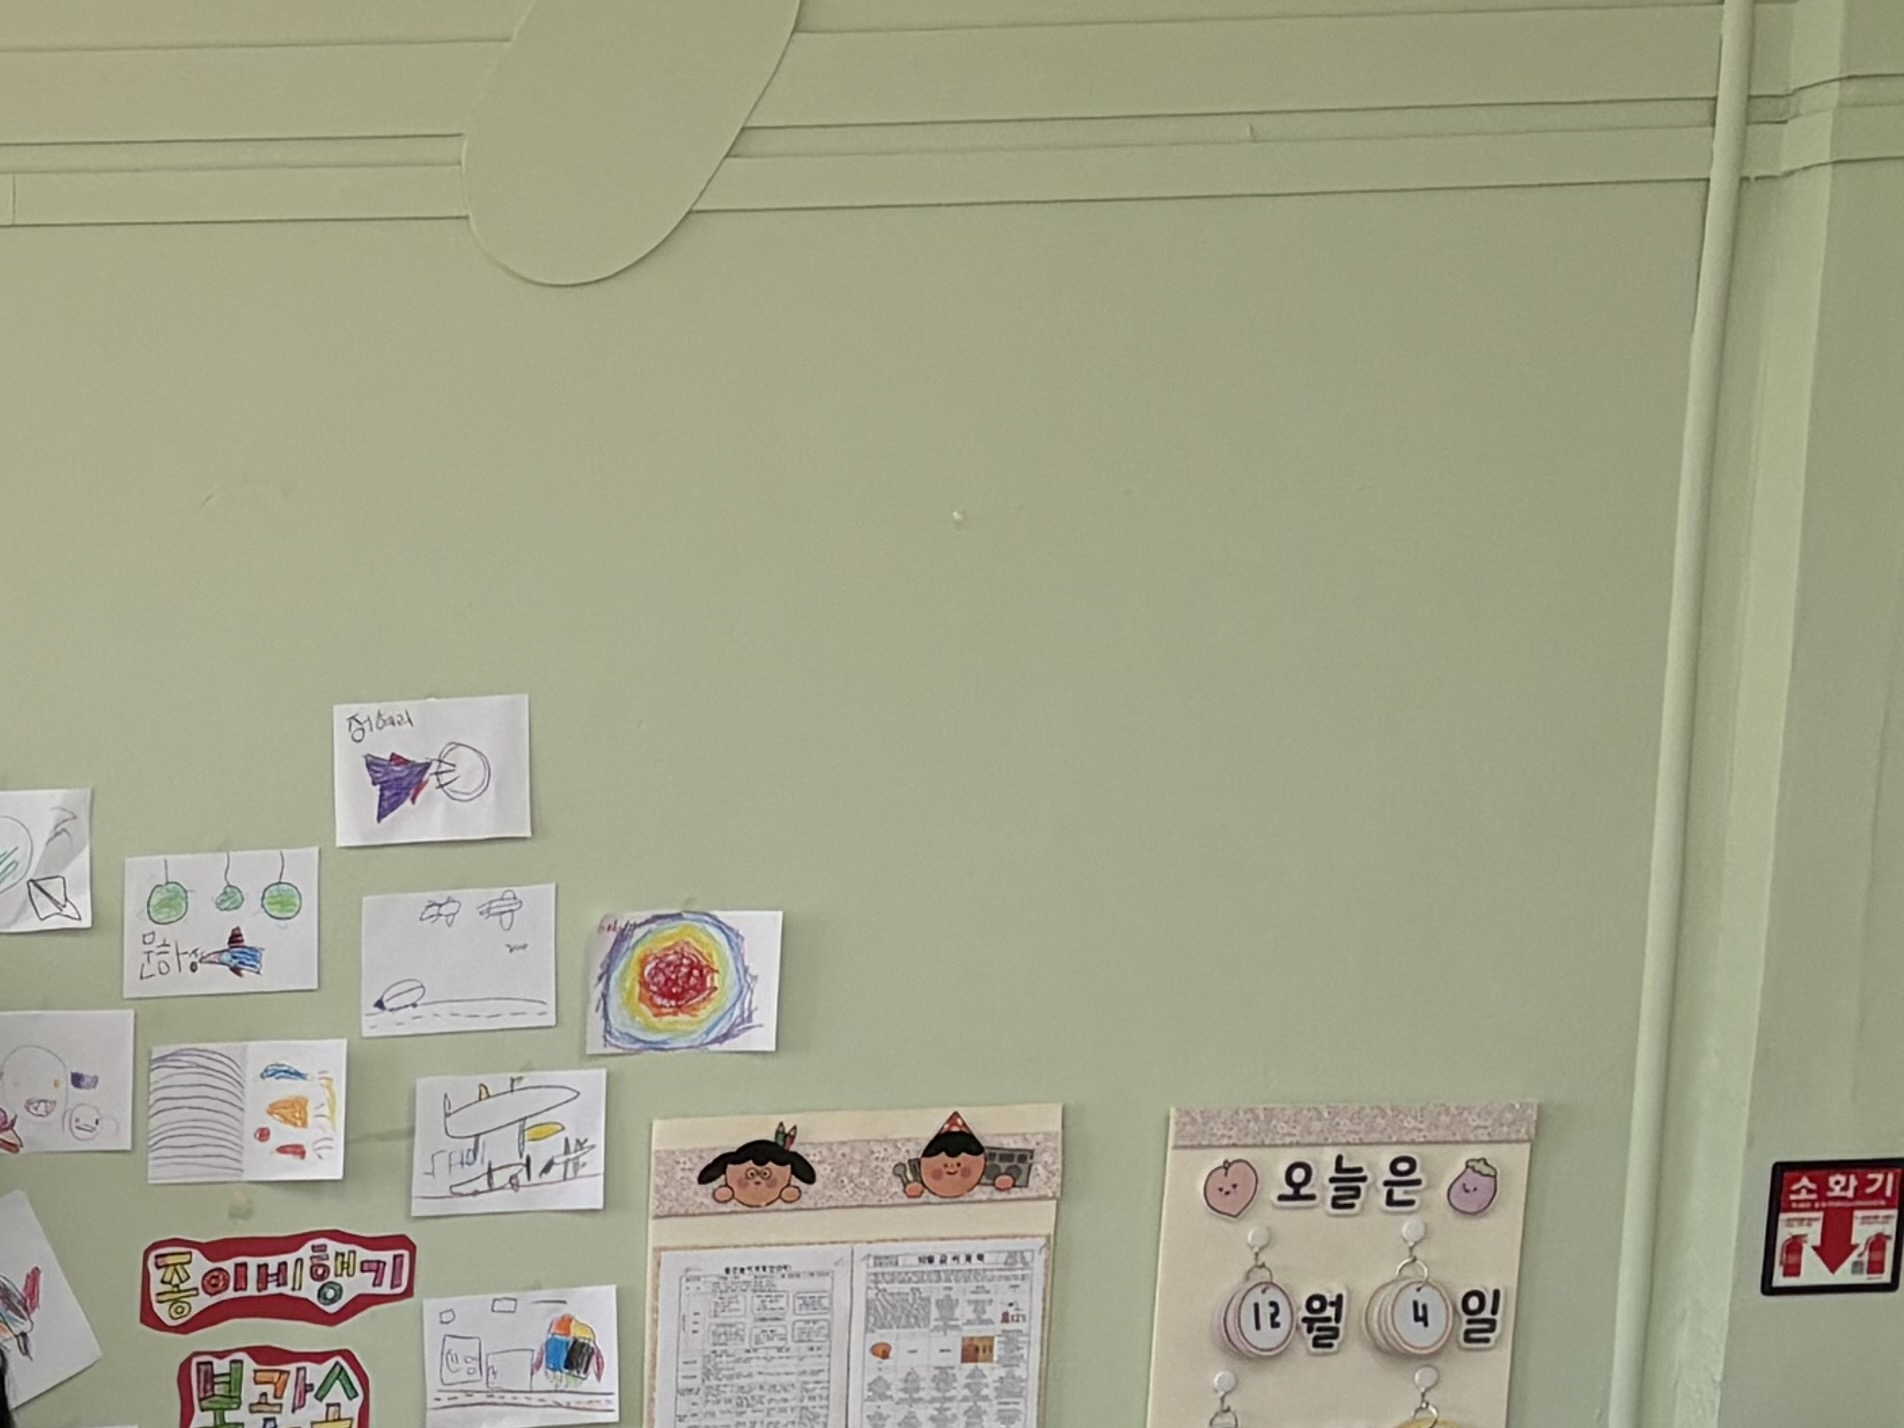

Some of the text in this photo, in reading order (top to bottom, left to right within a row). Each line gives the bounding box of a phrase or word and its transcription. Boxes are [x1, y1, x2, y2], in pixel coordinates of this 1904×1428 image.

[1276, 1153, 1423, 1211] 오늘은
[1789, 1171, 1894, 1199] 소화기
[155, 1243, 407, 1321] 종이비행기
